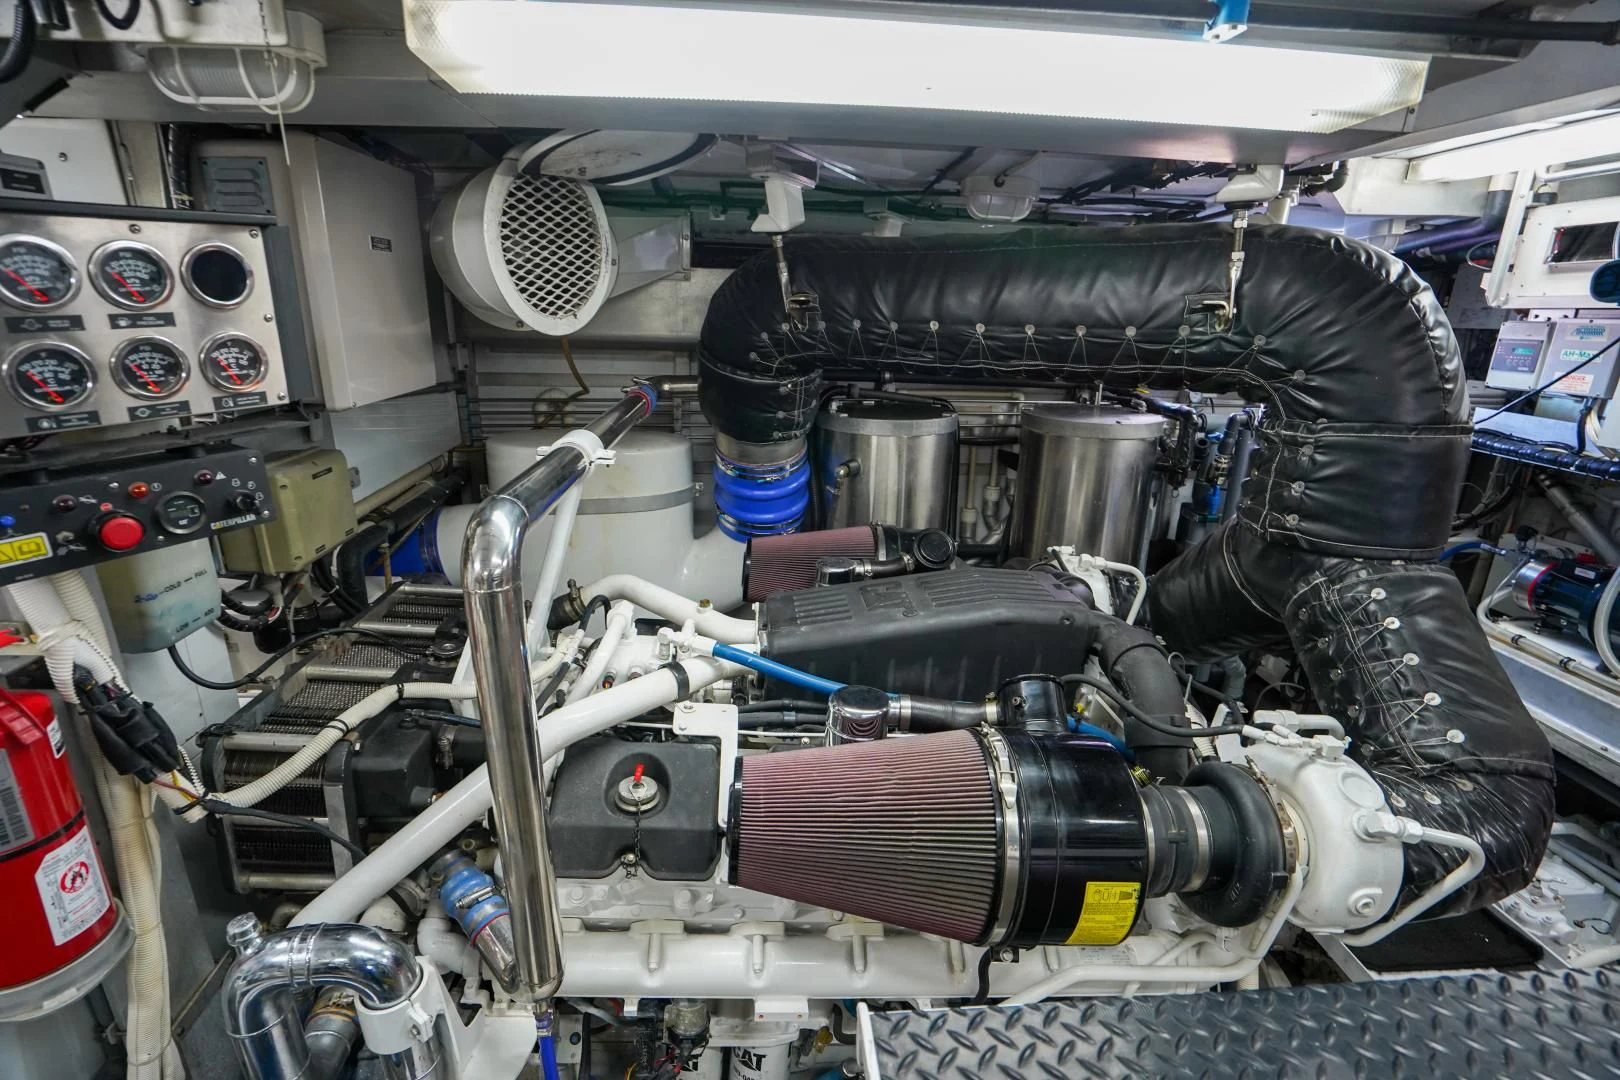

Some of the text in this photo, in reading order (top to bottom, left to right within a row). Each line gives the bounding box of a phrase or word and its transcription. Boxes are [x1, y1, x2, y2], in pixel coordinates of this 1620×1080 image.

[211, 514, 257, 530] CATERPILLAR
[164, 581, 181, 593] COLD
[732, 1046, 767, 1072] CAT
